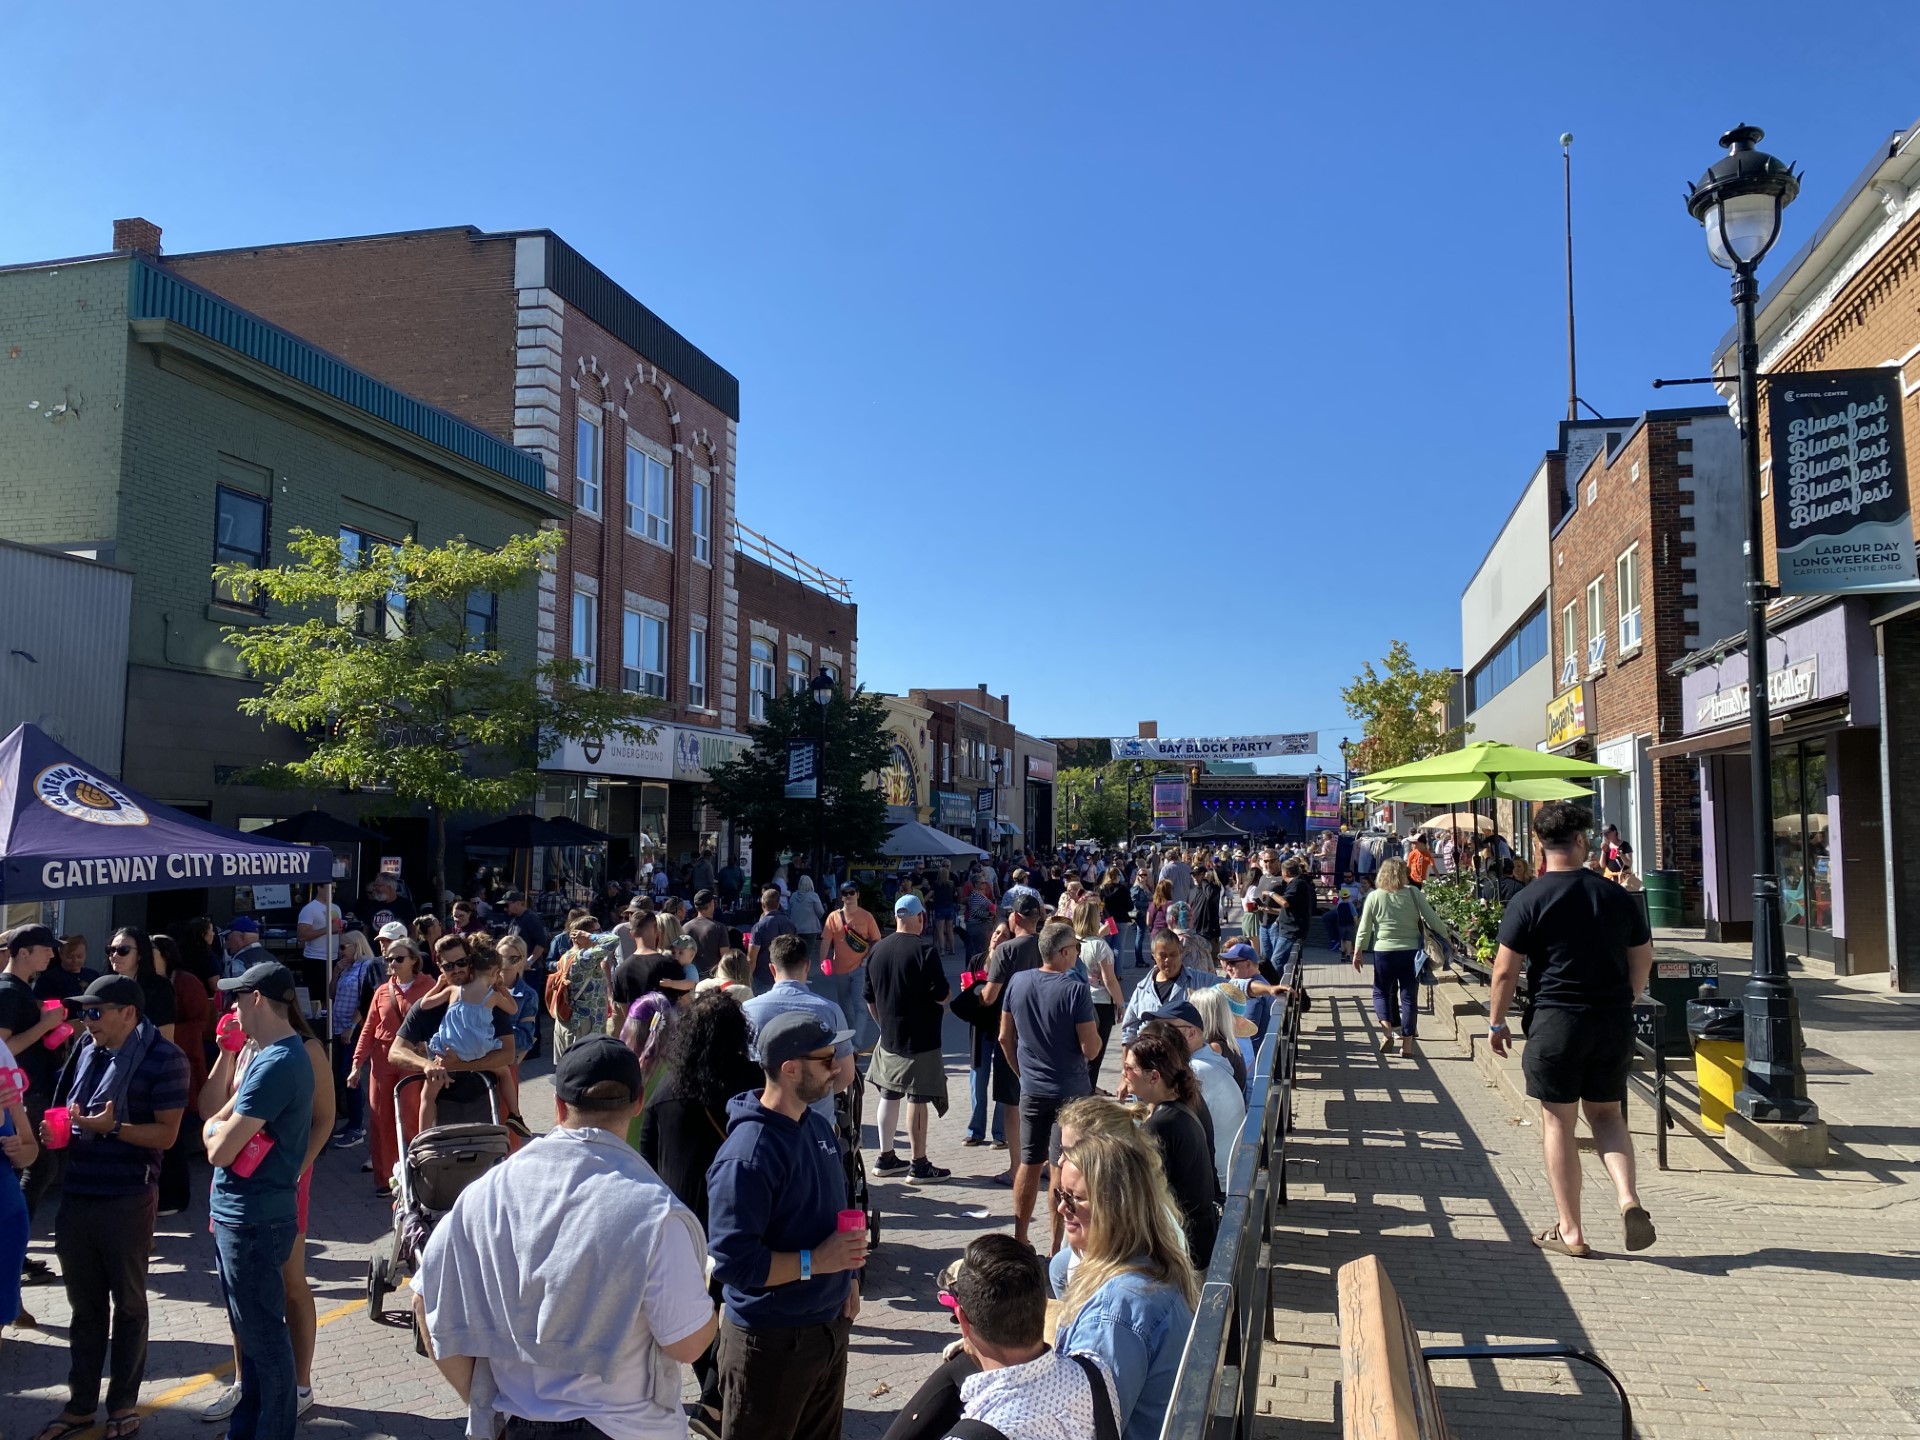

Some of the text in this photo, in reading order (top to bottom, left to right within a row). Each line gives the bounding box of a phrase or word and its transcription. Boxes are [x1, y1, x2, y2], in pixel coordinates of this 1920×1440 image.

[1787, 394, 1889, 443] Bluesfest
[1788, 416, 1890, 464] Bluesfest
[1788, 437, 1891, 486] Bluesfest
[1789, 459, 1892, 508] Bluesfest
[1789, 480, 1893, 530] Bluesfest
[1793, 552, 1901, 568] LONG WEEKEND
[1815, 542, 1900, 555] LABOUR DAY
[1793, 563, 1902, 576] CAPITOLCENTRE.ORG
[1548, 696, 1575, 742] Deegan's
[611, 746, 664, 762] UNDERGROUND
[1159, 744, 1183, 753] BAY
[1186, 743, 1228, 753] BLOCK
[1232, 742, 1273, 752] PARTY
[42, 766, 88, 806] GATEWAY
[41, 851, 311, 889] GATEWAY CITY BREWERY
